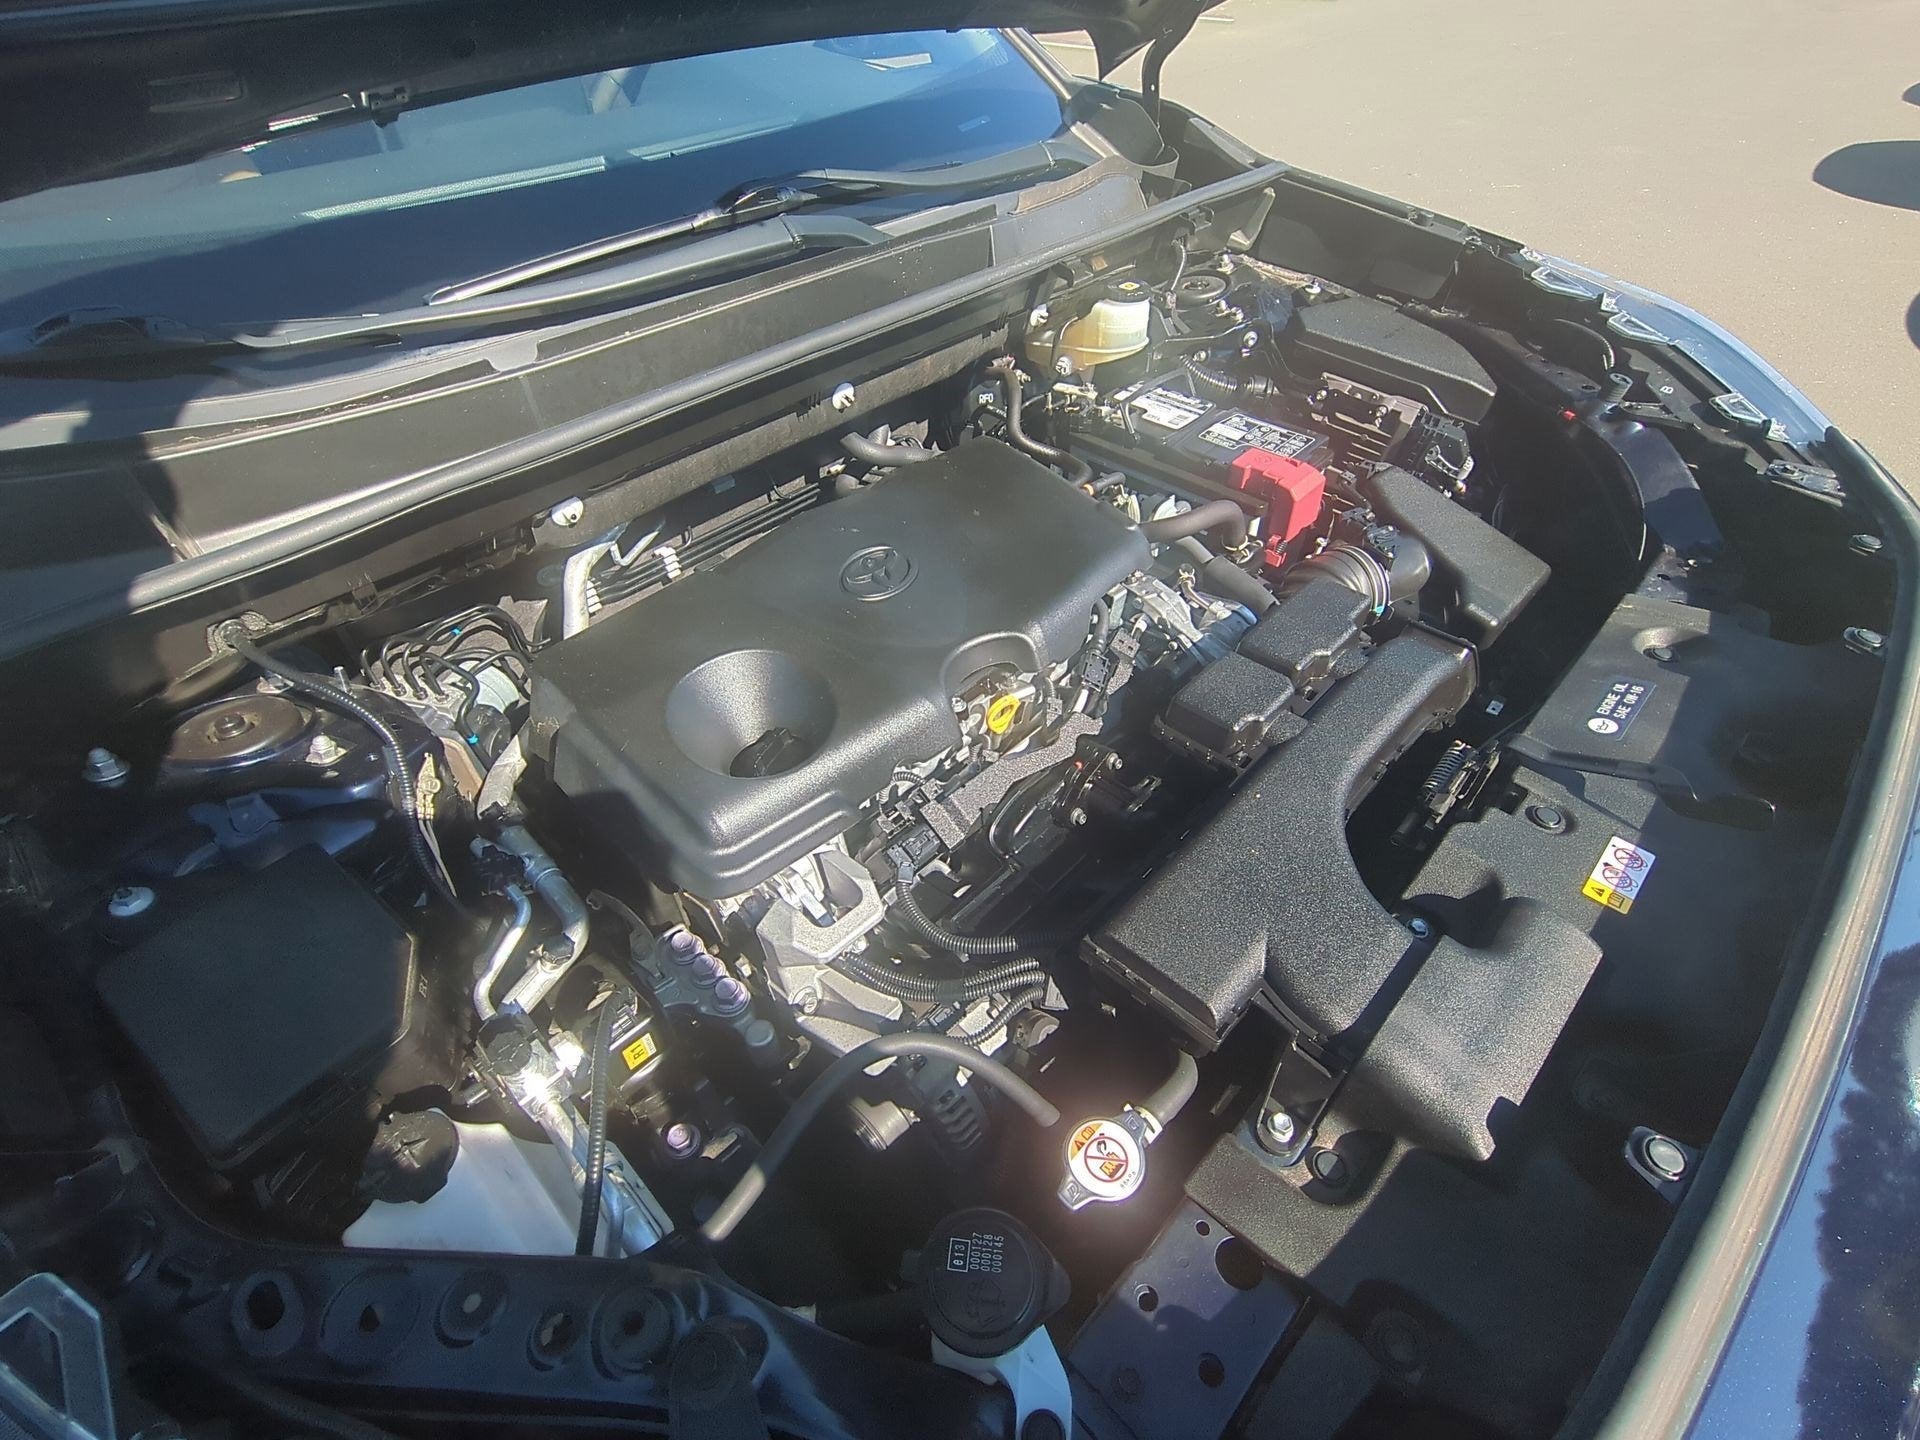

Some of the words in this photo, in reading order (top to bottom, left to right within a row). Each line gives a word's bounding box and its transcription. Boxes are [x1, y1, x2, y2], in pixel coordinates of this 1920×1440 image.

[1596, 693, 1621, 715] ENGINE
[1612, 683, 1630, 693] OIL
[1613, 705, 1632, 719] SAE
[630, 1043, 645, 1060] R1
[952, 1244, 966, 1266] e13
[969, 1232, 982, 1270] 000127
[980, 1234, 994, 1272] 000128
[991, 1235, 1004, 1273] 000145
